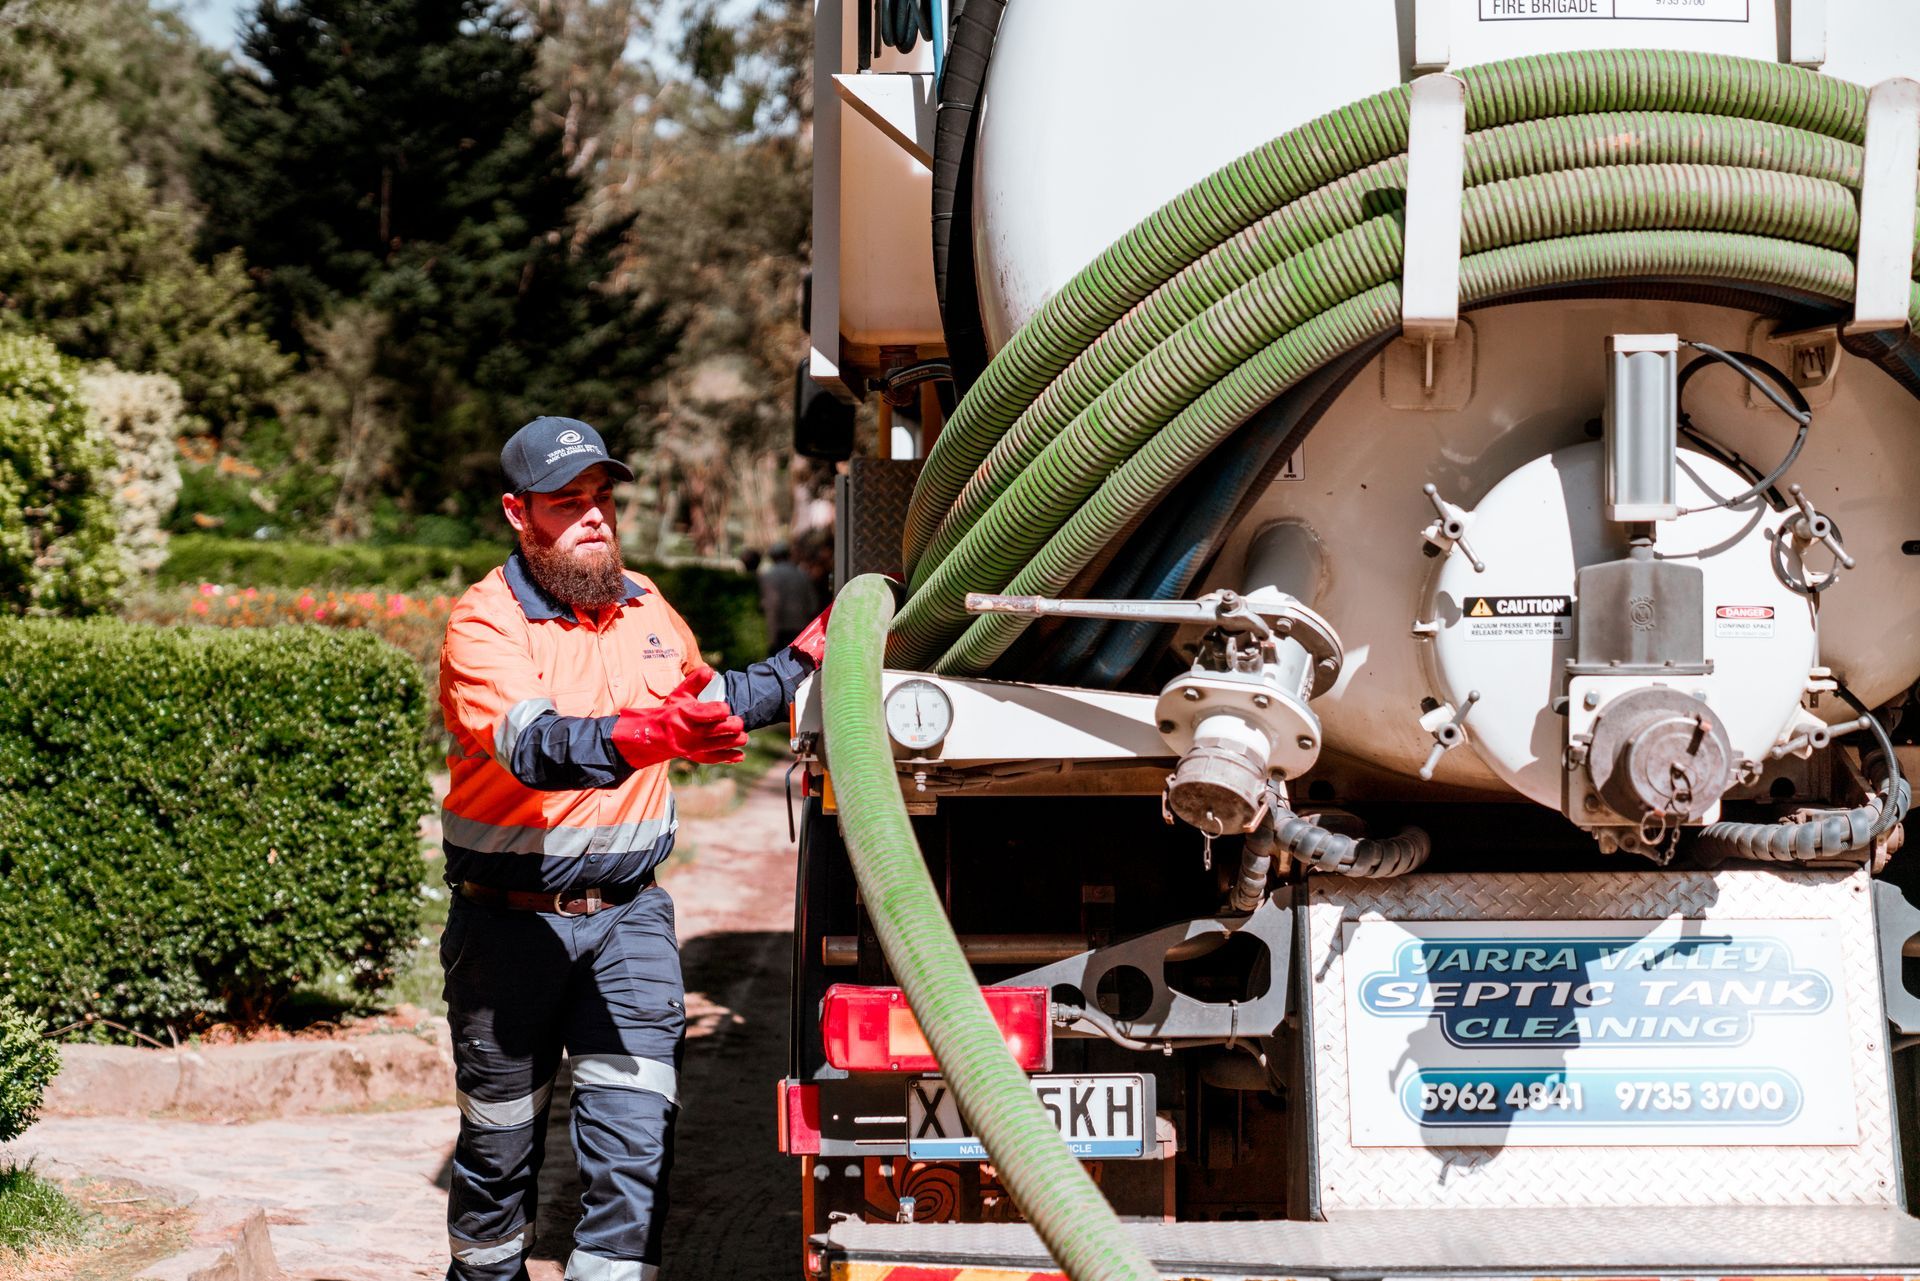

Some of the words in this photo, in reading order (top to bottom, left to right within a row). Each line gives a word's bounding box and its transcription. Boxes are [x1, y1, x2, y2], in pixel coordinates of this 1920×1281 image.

[1493, 0, 1526, 14] FIRE
[1531, 0, 1598, 13] BRIGADE
[1496, 599, 1565, 614] CAUTION
[1725, 607, 1765, 617] DANGER
[1411, 947, 1578, 974] YARRA
[1599, 946, 1775, 972] VALLEY
[1374, 981, 1616, 1008] SEPTIC
[1640, 979, 1817, 1006] TANK
[1454, 1016, 1740, 1039] CLEANING
[1419, 1082, 1497, 1111] 5962
[1504, 1081, 1583, 1111] 4841
[1615, 1081, 1692, 1111] 9735
[1700, 1081, 1785, 1111] 3700
